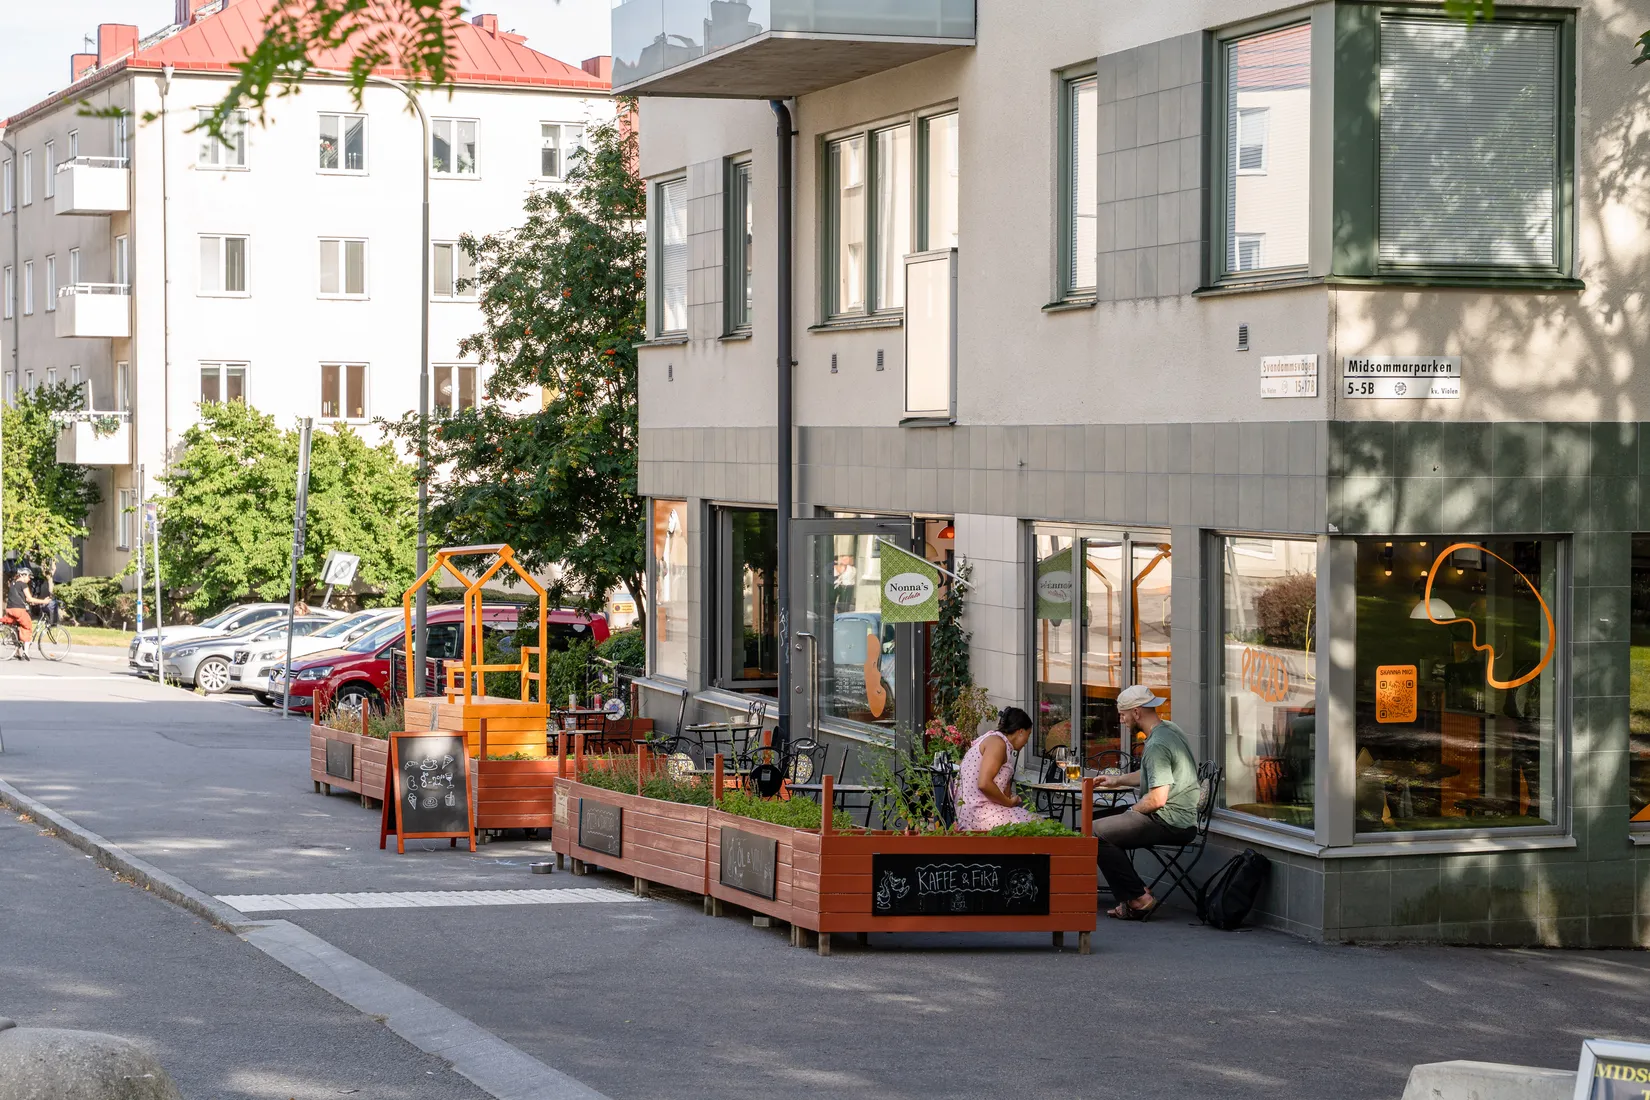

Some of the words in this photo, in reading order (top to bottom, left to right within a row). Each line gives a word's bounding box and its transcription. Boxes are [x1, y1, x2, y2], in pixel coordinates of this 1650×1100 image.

[1348, 359, 1453, 376] Midsommarparken
[1295, 380, 1316, 393] 15-17B
[1347, 381, 1375, 395] 5-5B
[1441, 387, 1459, 395] Violen
[890, 582, 929, 592] Nonna's
[898, 591, 921, 603] Gelato
[1241, 647, 1289, 703] PEZZO
[917, 870, 958, 891] KAFFE
[961, 872, 970, 886] &
[1594, 1063, 1650, 1083] MIDS
